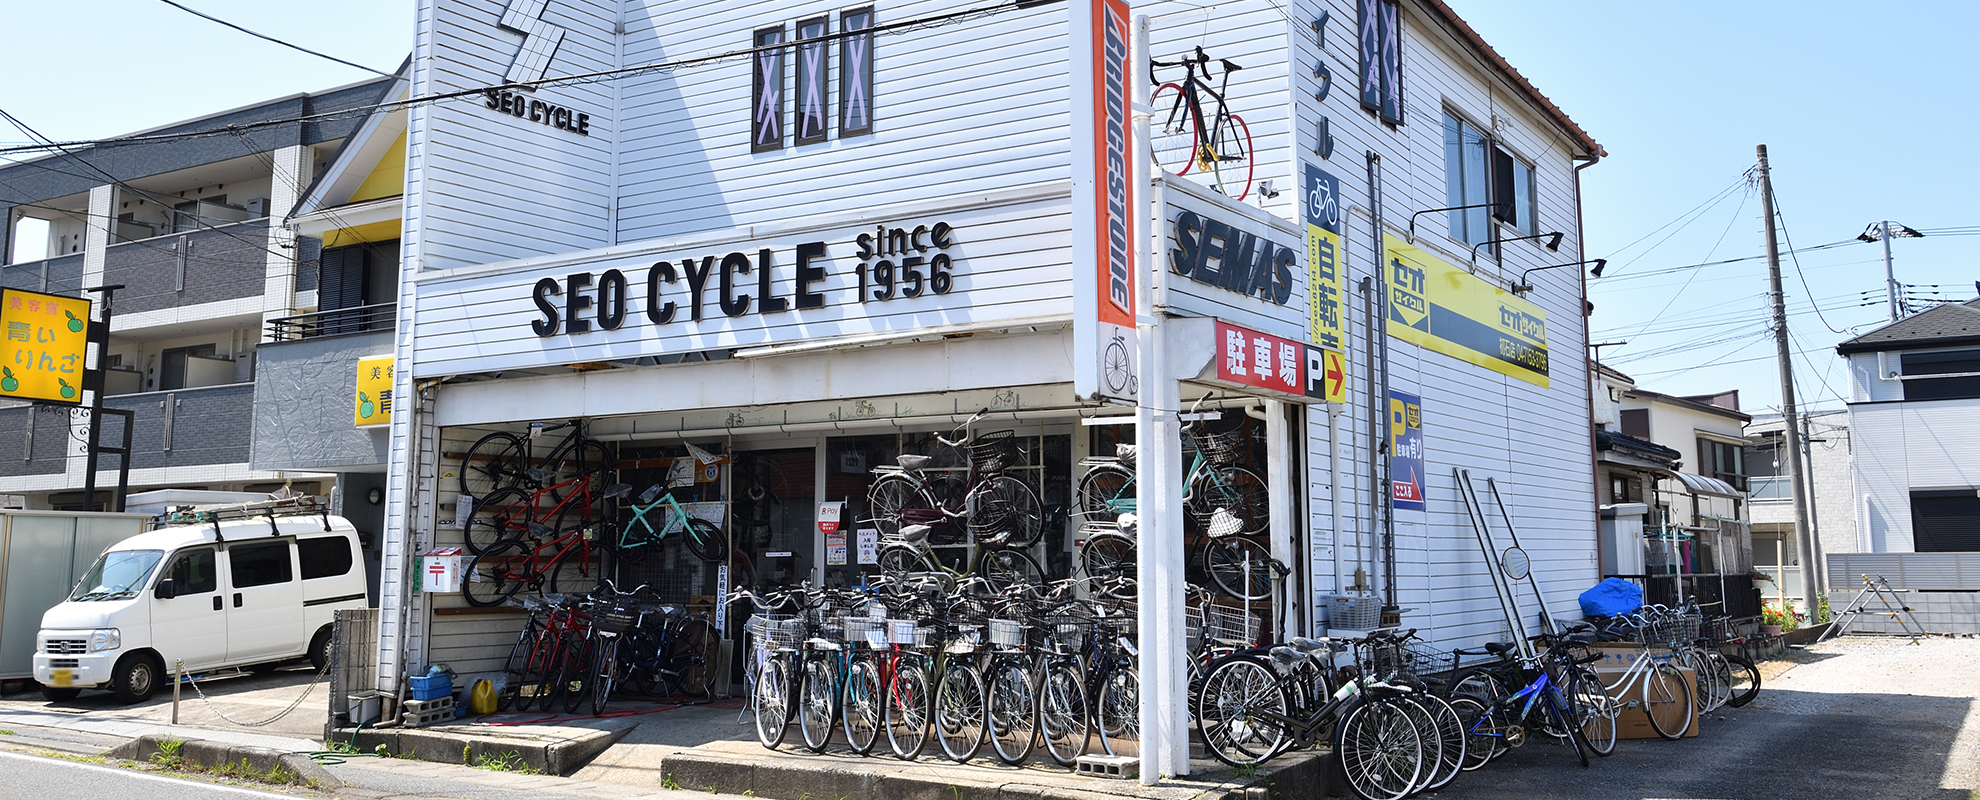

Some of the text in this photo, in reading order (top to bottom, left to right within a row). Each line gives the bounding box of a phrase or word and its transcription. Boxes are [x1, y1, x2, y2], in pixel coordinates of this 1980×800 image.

[485, 88, 590, 137] SEO CYCLE
[1104, 2, 1130, 316] BRIDGESTONE
[856, 221, 953, 260] since
[1169, 211, 1296, 306] SEMAS
[531, 241, 828, 338] SEO CYCLE
[855, 253, 953, 304] 1956
[1391, 257, 1425, 295] セオ
[9, 296, 59, 316] 美容室
[1394, 290, 1424, 312] サイクル
[7, 320, 56, 343] 青い
[15, 349, 80, 373] りんご
[1226, 329, 1323, 391] 駐車場 P
[1390, 398, 1406, 457] P
